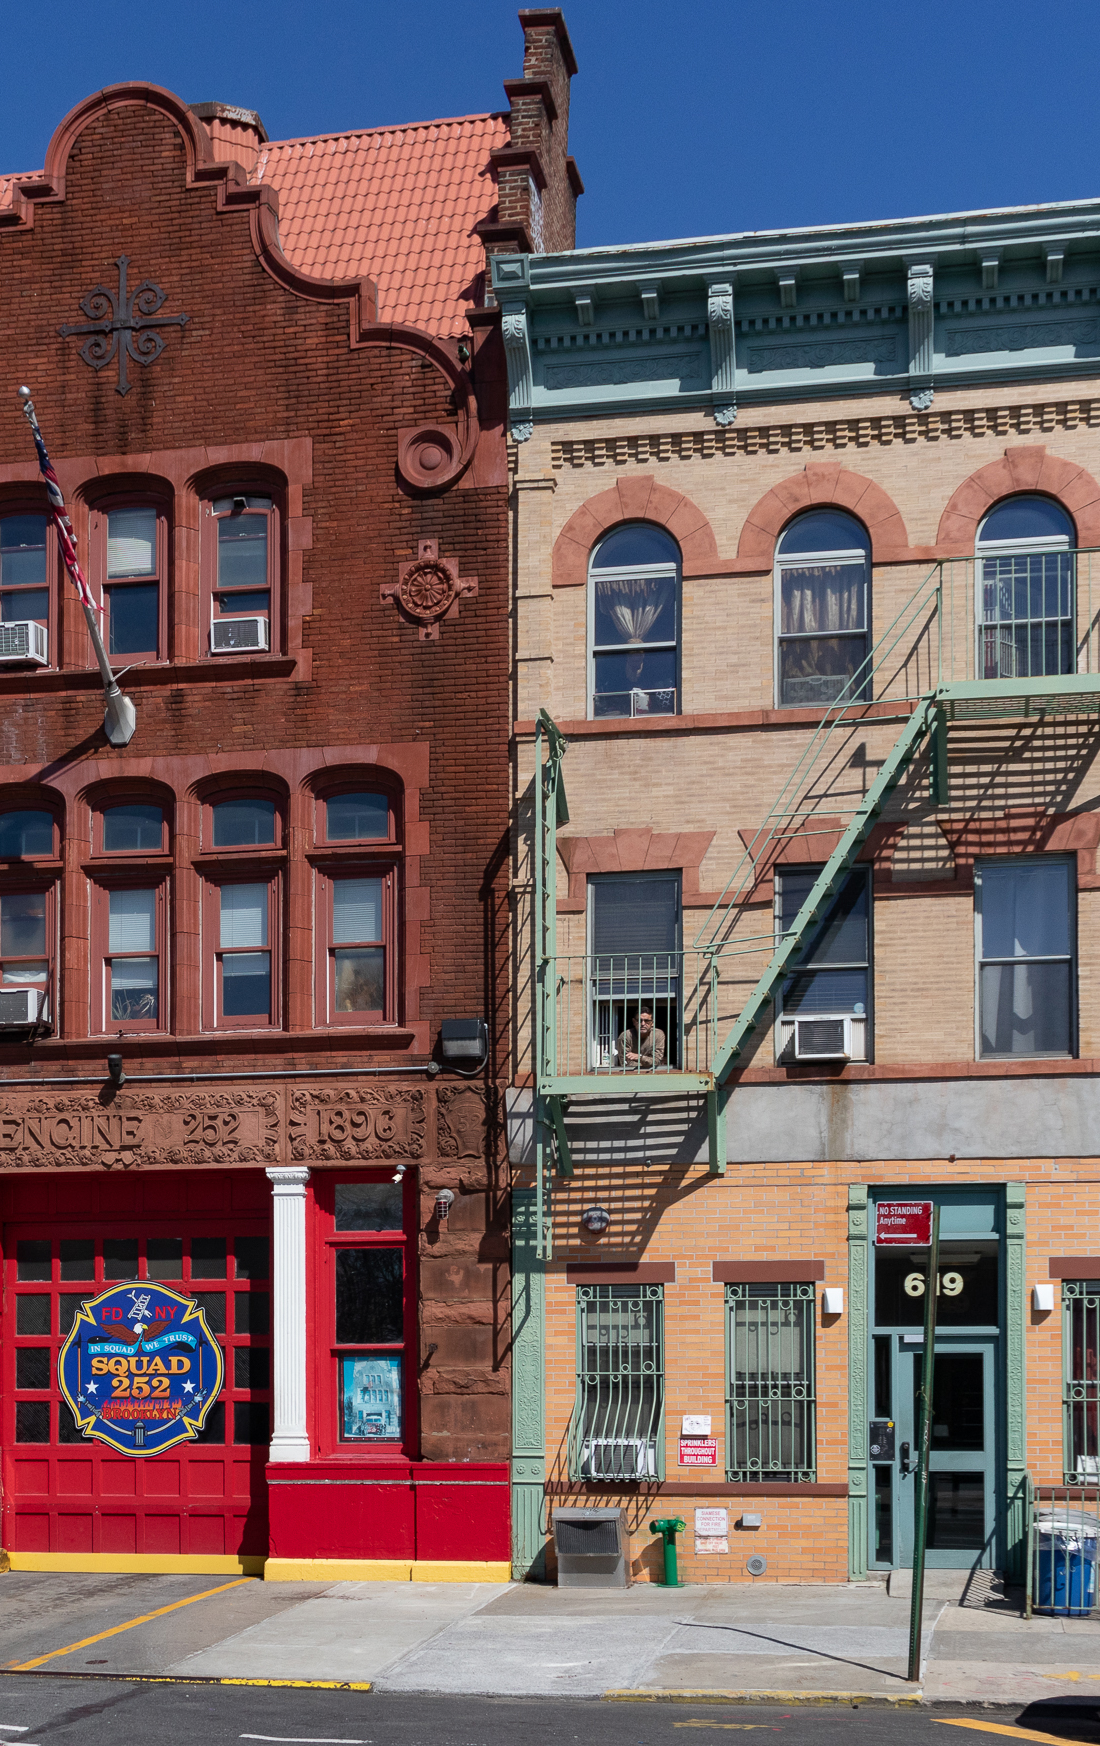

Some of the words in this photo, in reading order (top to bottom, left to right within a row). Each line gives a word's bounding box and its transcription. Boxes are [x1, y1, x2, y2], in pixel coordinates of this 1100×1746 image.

[183, 1109, 241, 1147] 252
[316, 1106, 397, 1145] 1896
[457, 1112, 482, 1133] 52
[880, 1207, 889, 1215] NO
[890, 1206, 923, 1215] STANDING
[879, 1216, 907, 1226] Anytime
[101, 1307, 123, 1321] FD
[155, 1305, 178, 1320] NY
[90, 1345, 101, 1353] IN
[104, 1345, 135, 1355] SQUAD
[145, 1340, 160, 1351] WE
[162, 1333, 194, 1344] TRUST
[91, 1356, 192, 1377] SQUAD
[110, 1376, 171, 1399] 252
[102, 1407, 178, 1421] BROOKLYN
[680, 1439, 716, 1447] SPRINKLERS
[680, 1447, 716, 1455] THROUGHOUT
[683, 1455, 713, 1463] BUILDING
